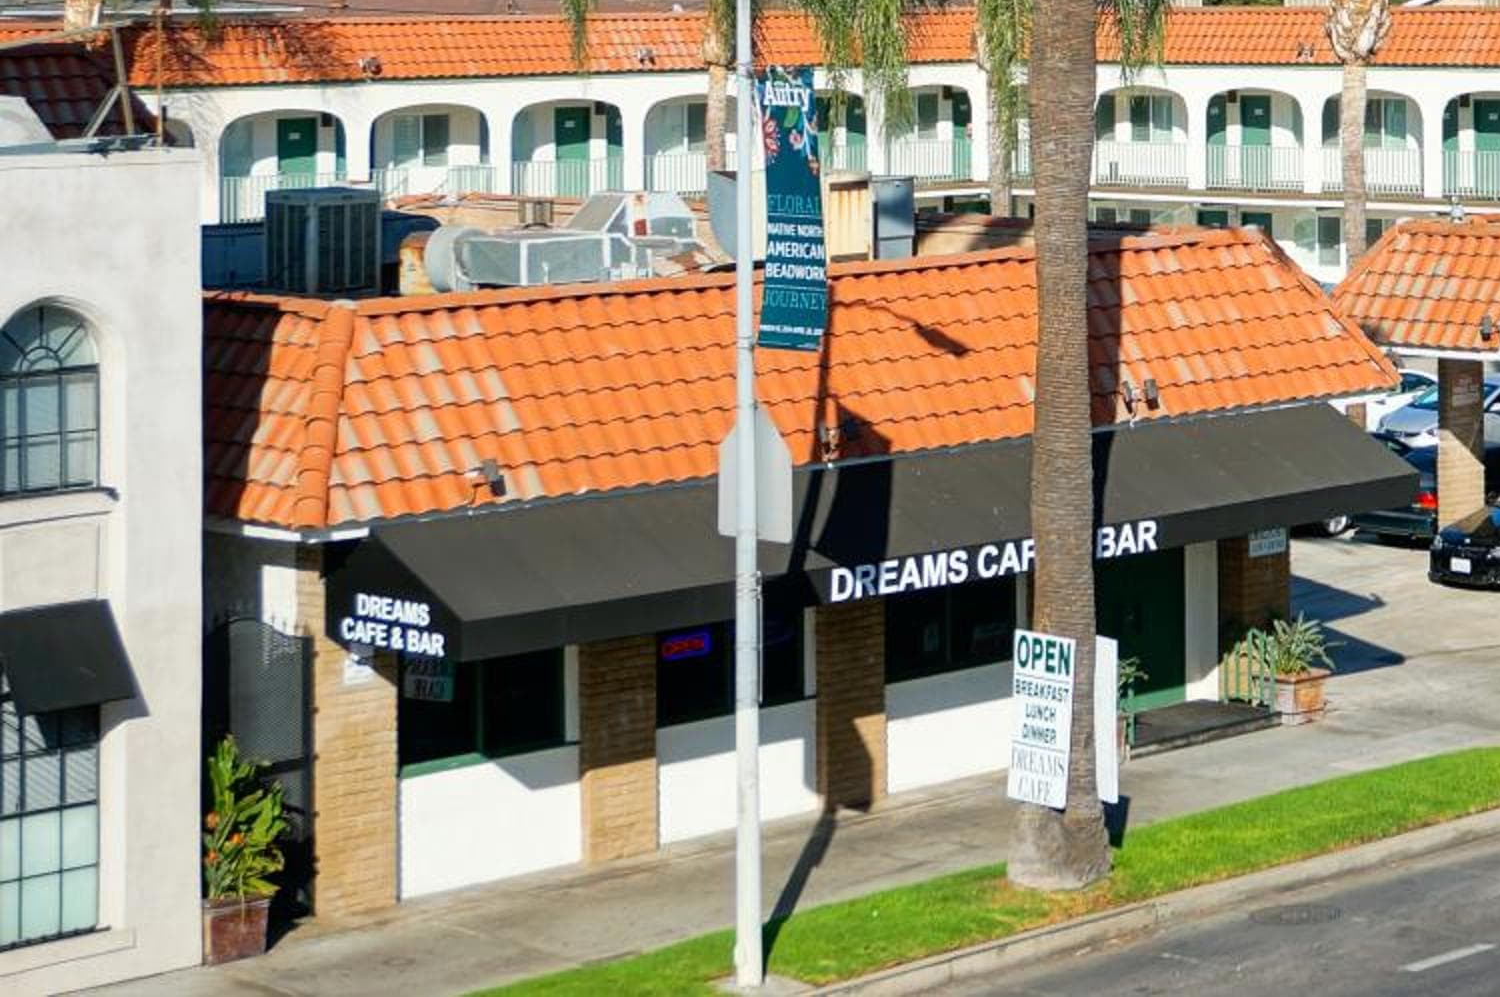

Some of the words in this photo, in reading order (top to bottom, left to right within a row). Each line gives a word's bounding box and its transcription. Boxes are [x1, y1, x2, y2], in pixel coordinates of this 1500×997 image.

[763, 80, 810, 112] Autry
[767, 222, 797, 236] NATIVE
[767, 241, 825, 260] AMERICAN
[765, 263, 827, 282] BEADWORK
[831, 550, 969, 603] DREAMS
[977, 538, 1035, 579] CAF
[1097, 520, 1159, 560] BAR
[356, 592, 431, 627] DREAMS
[341, 617, 388, 648] CAFE
[390, 626, 404, 651] &
[406, 629, 446, 658] BAR
[1017, 634, 1071, 676] OPEN
[1015, 678, 1070, 704] BREAKFAST
[1025, 703, 1057, 723] LUNCH
[1022, 723, 1057, 745] DINNER
